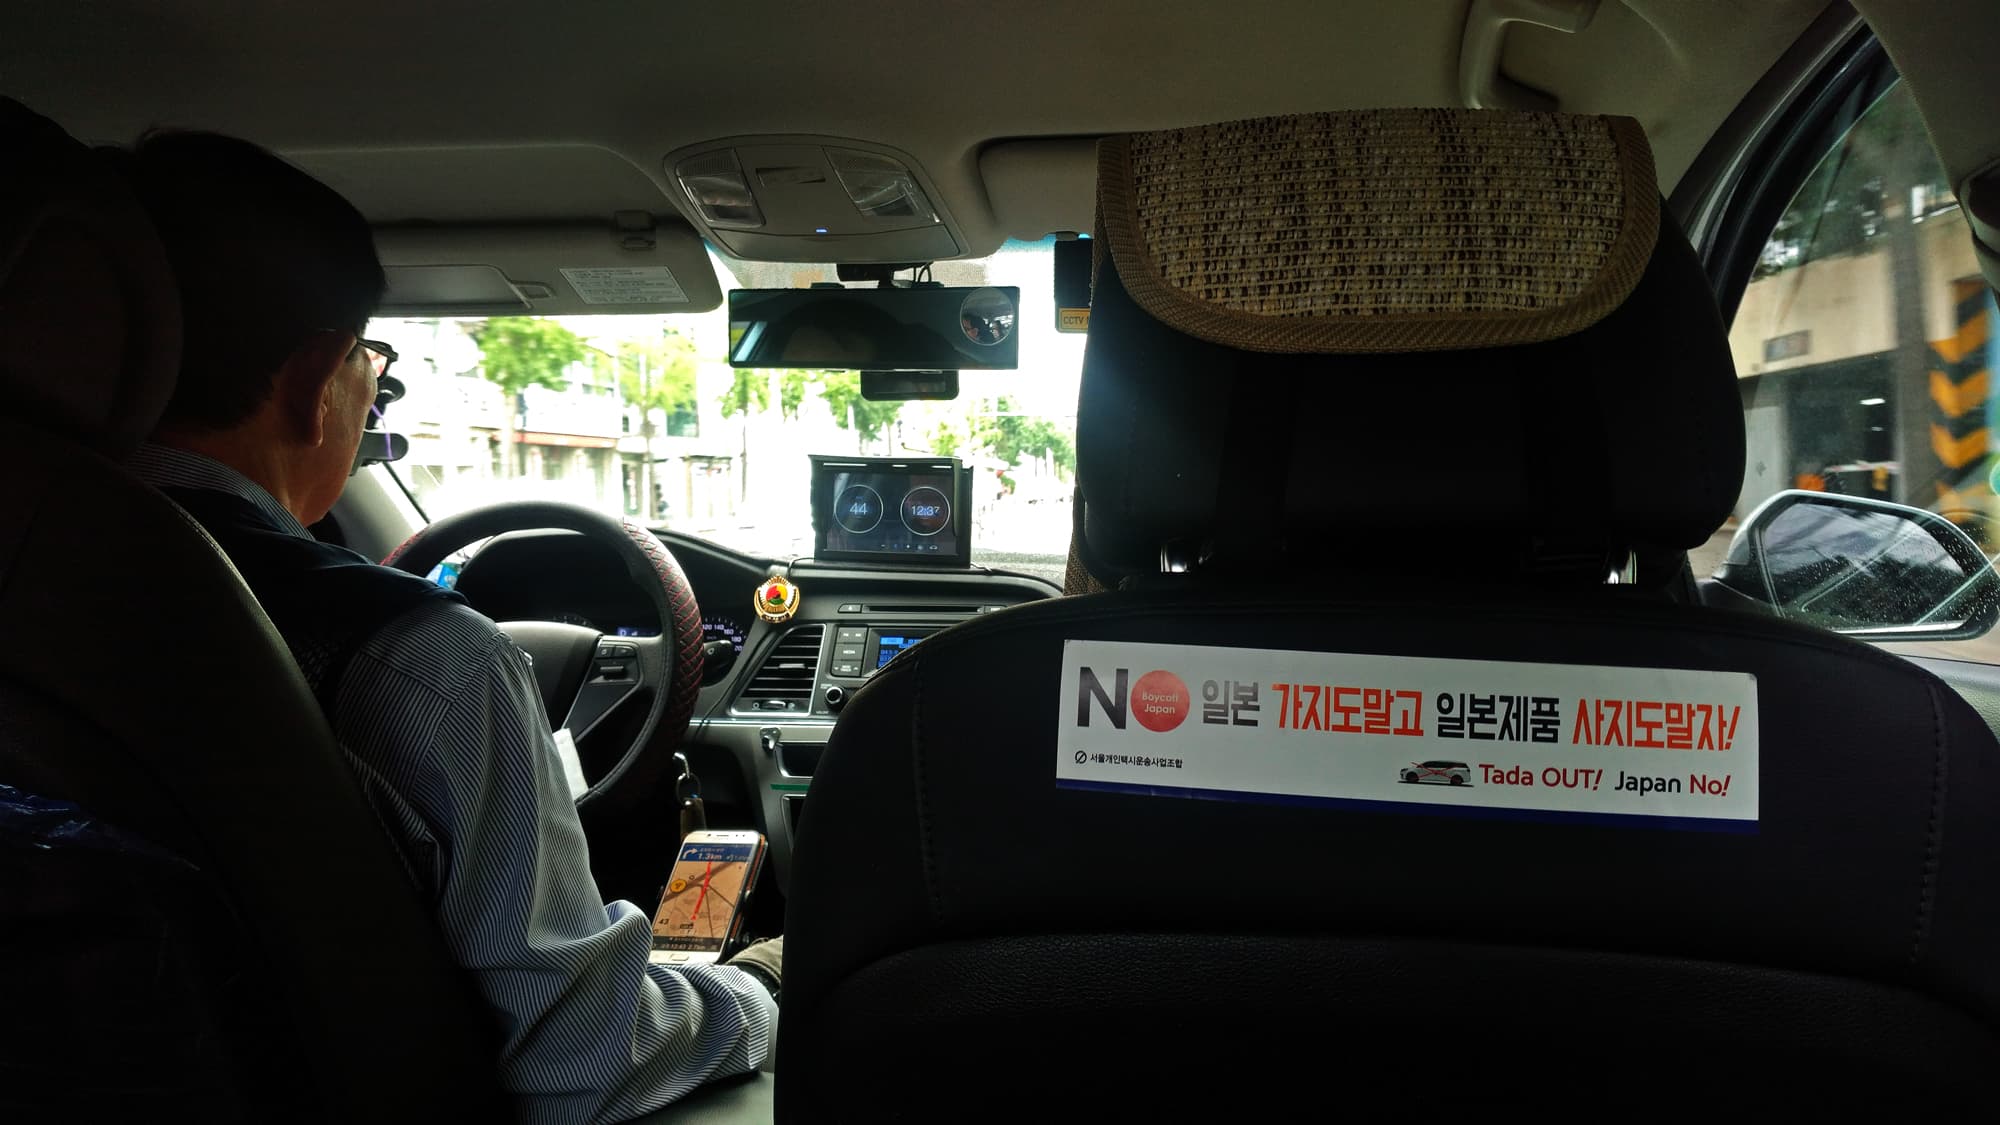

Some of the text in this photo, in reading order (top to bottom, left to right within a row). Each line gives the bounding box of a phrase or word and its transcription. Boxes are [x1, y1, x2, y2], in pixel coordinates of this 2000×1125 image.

[1063, 316, 1086, 325] CCTV
[849, 502, 868, 515] 44
[911, 505, 940, 516] 12:37
[1144, 703, 1176, 715] Japan
[1202, 680, 1260, 727] 일본
[1271, 684, 1424, 736] 가지도말고
[1436, 693, 1561, 744] 일본제품
[1572, 699, 1741, 751] 사지도말자!
[1479, 764, 1731, 797] Tada OUT! Japan No!
